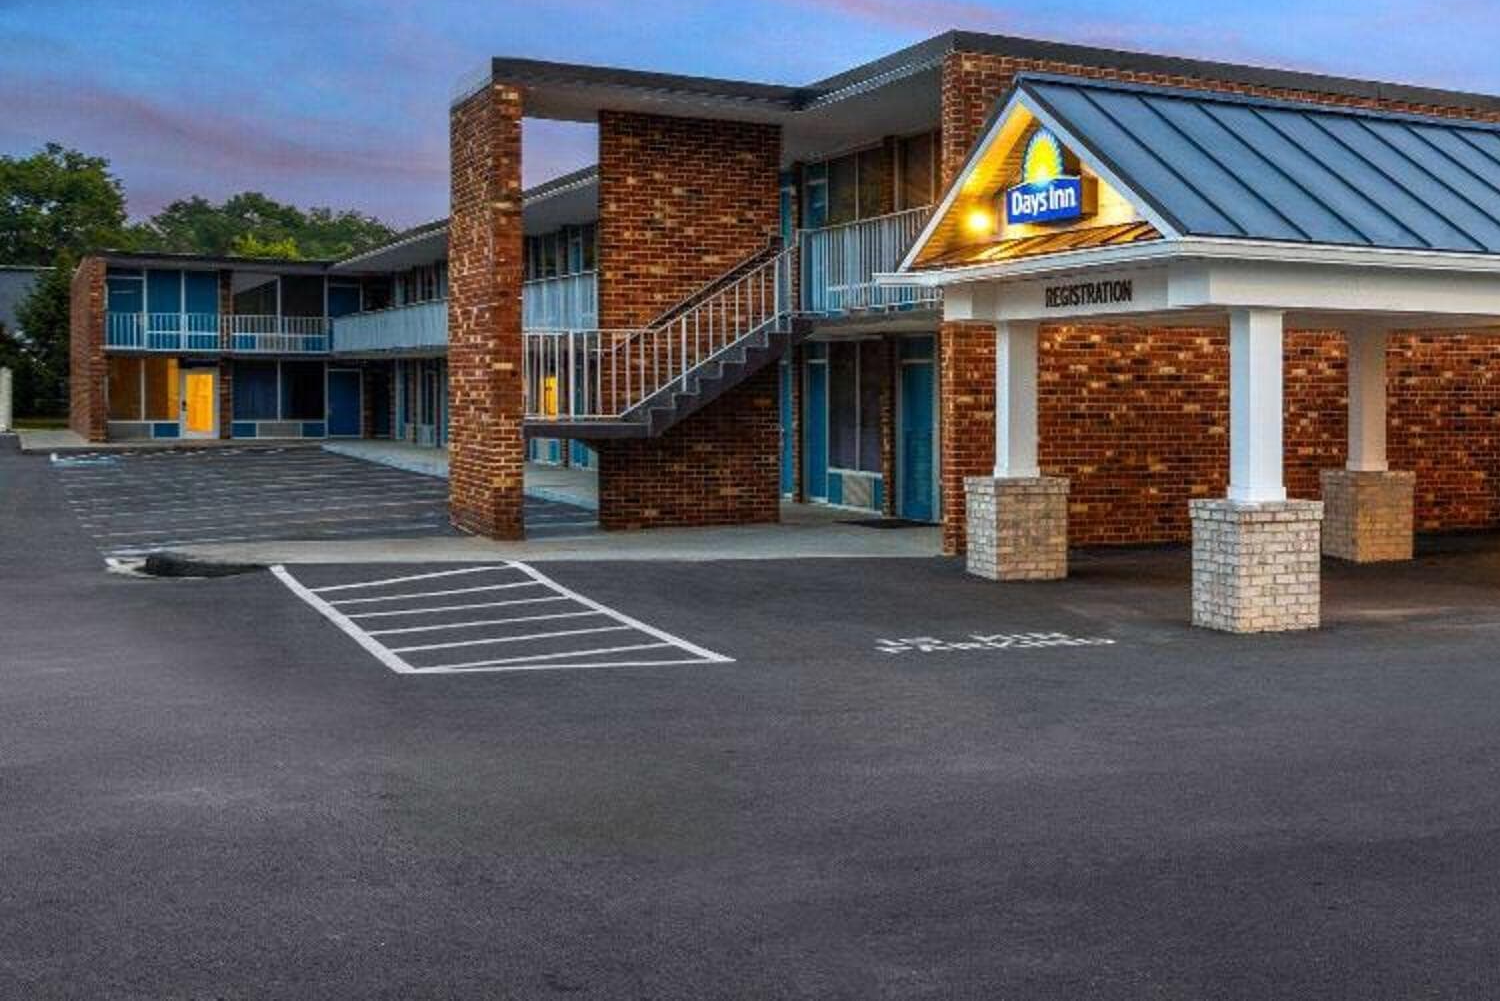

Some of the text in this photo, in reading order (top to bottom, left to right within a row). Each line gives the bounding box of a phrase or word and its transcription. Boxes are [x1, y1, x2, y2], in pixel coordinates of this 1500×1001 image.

[1011, 186, 1076, 216] Days Inn
[1045, 280, 1132, 308] REGISTRATION
